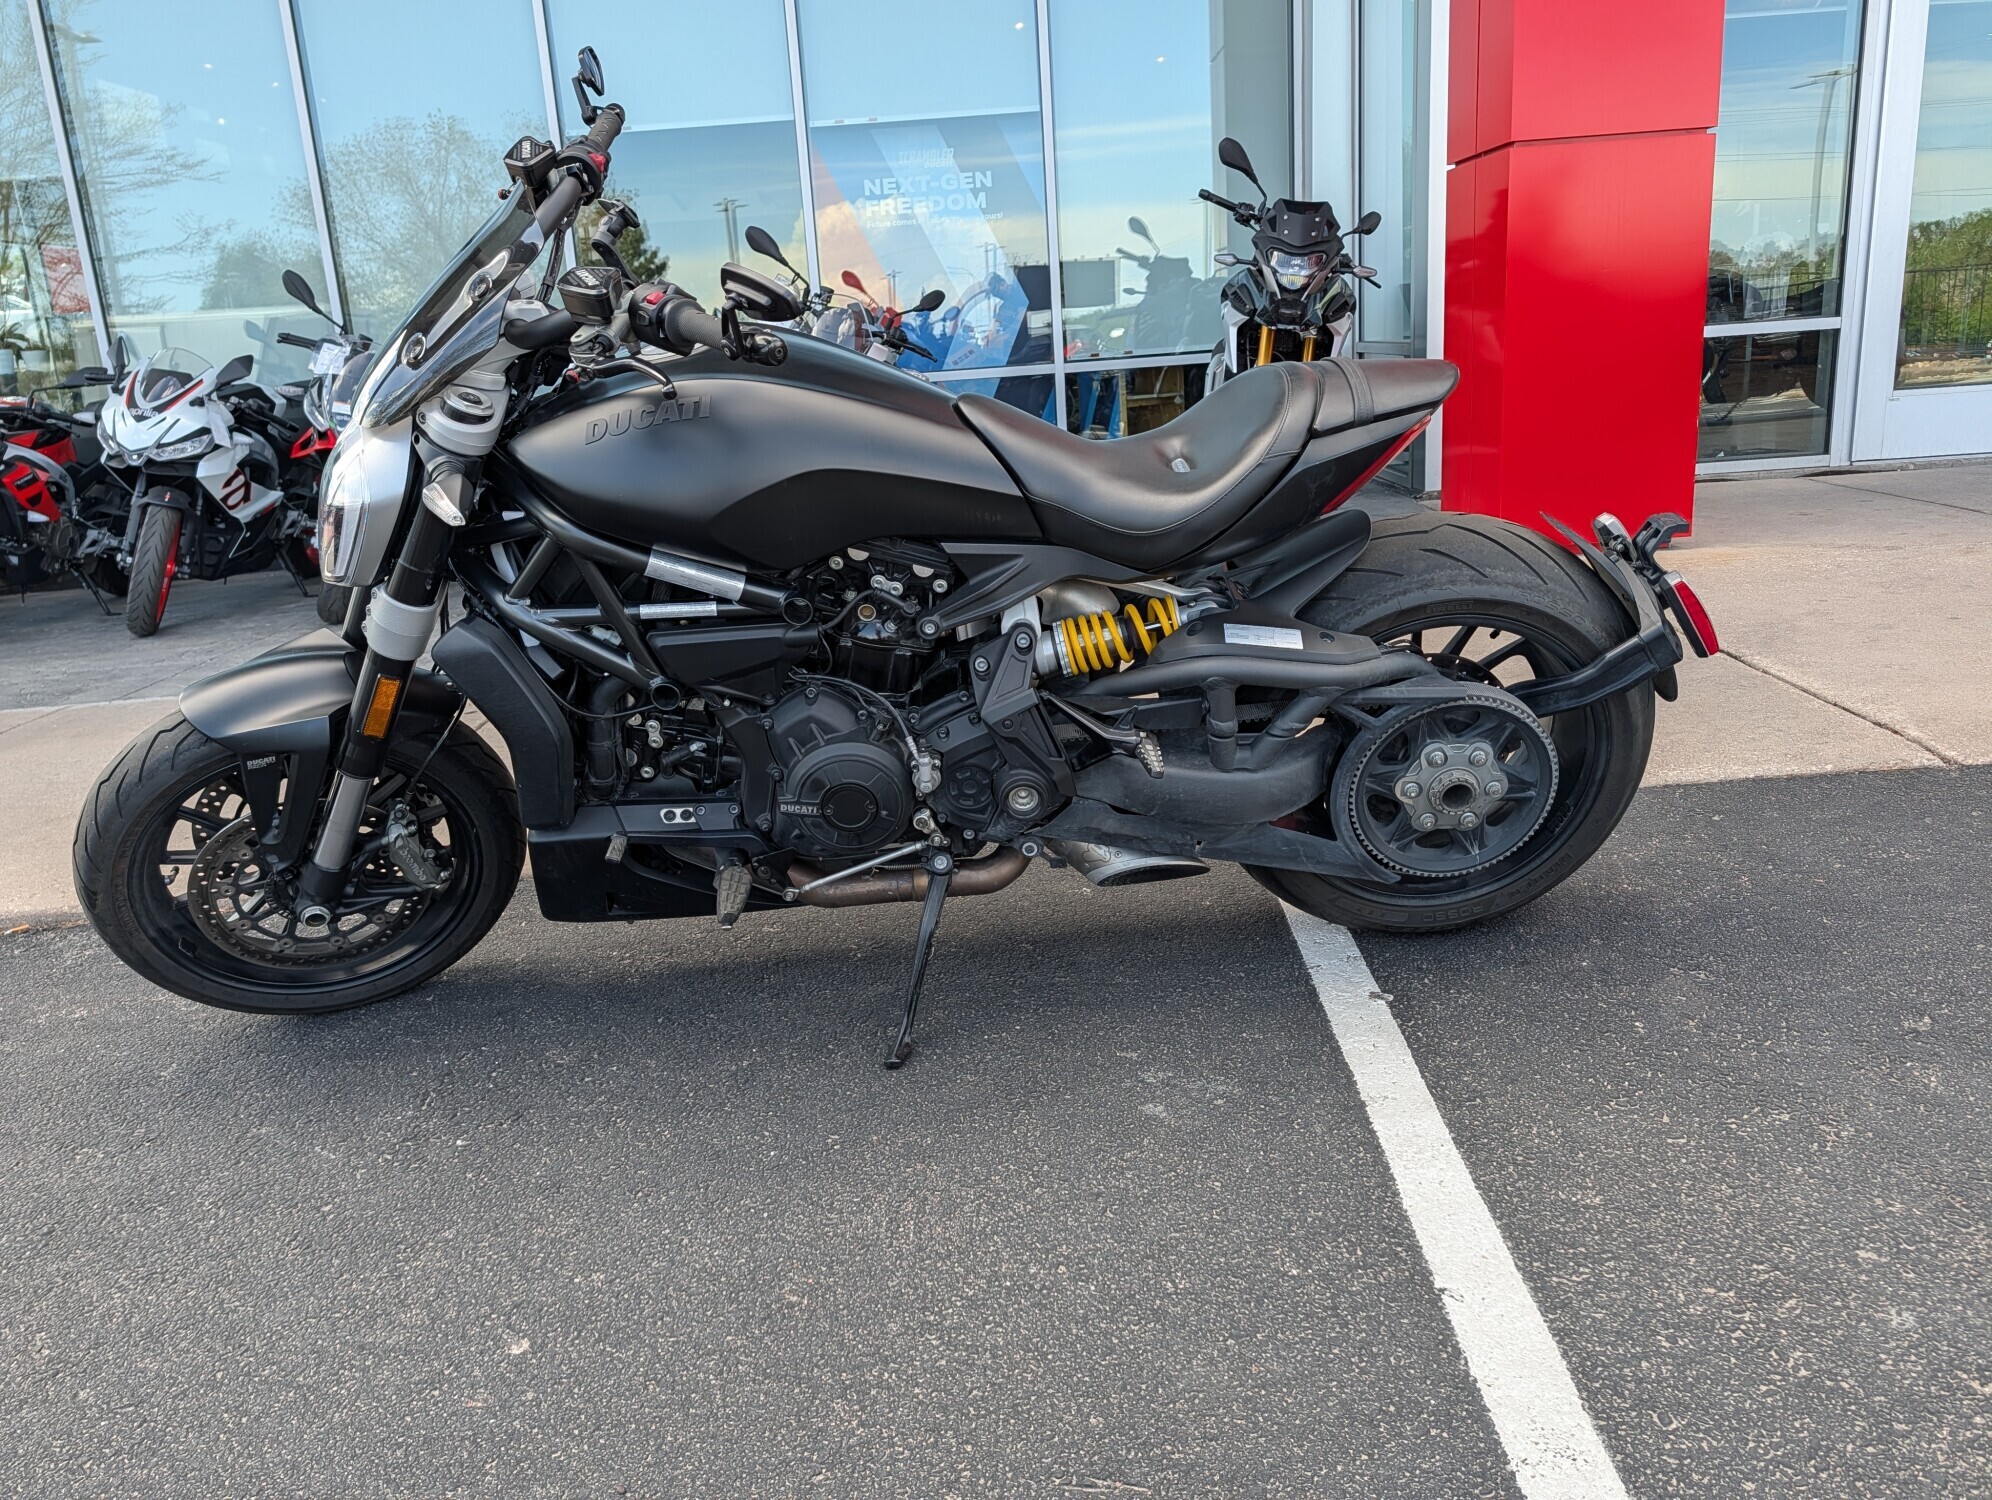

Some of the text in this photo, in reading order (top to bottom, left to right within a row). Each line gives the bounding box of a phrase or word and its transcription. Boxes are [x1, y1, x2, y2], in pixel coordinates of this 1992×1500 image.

[898, 148, 954, 164] SCRAMBLER
[924, 160, 954, 169] DUCATI
[863, 170, 993, 196] NEXT-GEN
[865, 191, 987, 217] FREEDOM
[867, 219, 891, 229] Future
[892, 218, 917, 227] comes
[129, 407, 159, 418] aprilia
[584, 395, 713, 446] DUCATI
[246, 756, 276, 767] DUCATI
[780, 804, 817, 814] DUCATI
[398, 847, 428, 882] brembo
[1423, 903, 1484, 922] ROSSO
